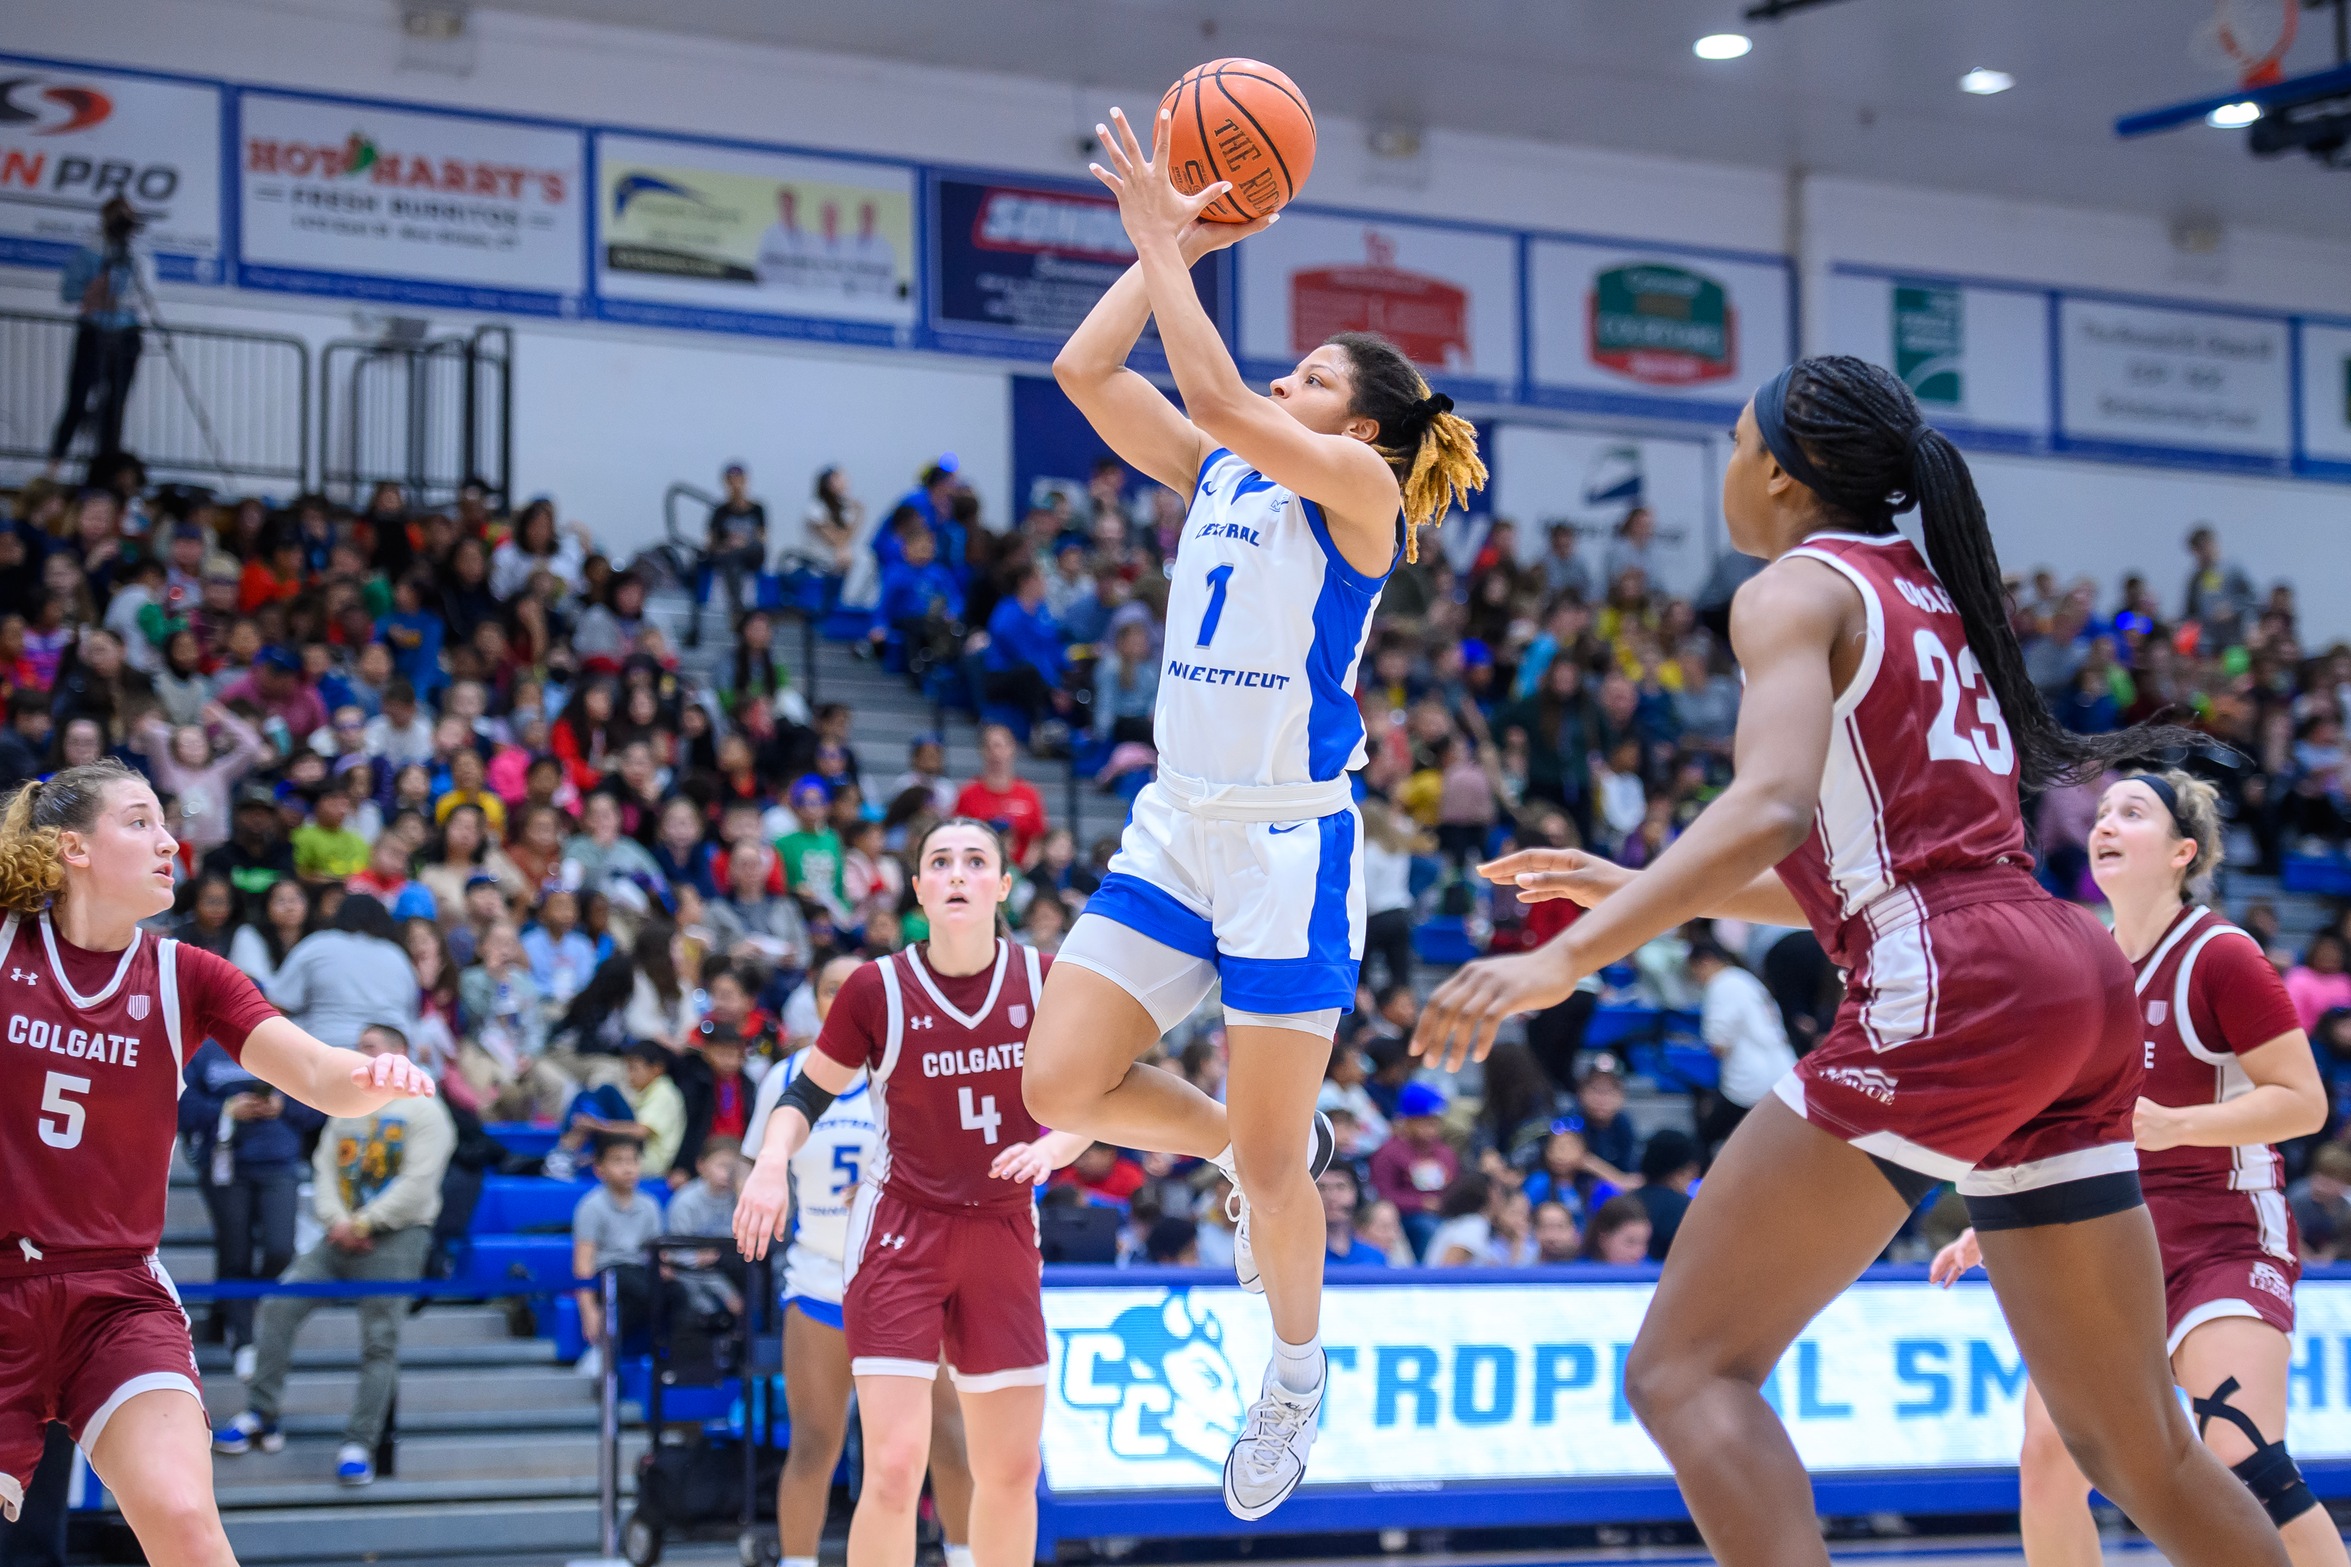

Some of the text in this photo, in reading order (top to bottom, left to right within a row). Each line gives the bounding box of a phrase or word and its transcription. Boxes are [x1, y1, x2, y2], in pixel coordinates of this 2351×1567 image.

[55, 156, 180, 201] PRO
[248, 138, 346, 179] HOT
[1214, 118, 1280, 216] THE ROCK
[1194, 562, 1235, 650] 1
[1913, 629, 2015, 775] 23
[8, 1014, 141, 1068] COLGATE
[922, 1042, 1025, 1078] COLGATE
[38, 1070, 92, 1150] 5
[957, 1086, 1002, 1145] 4
[832, 1146, 862, 1195] 5
